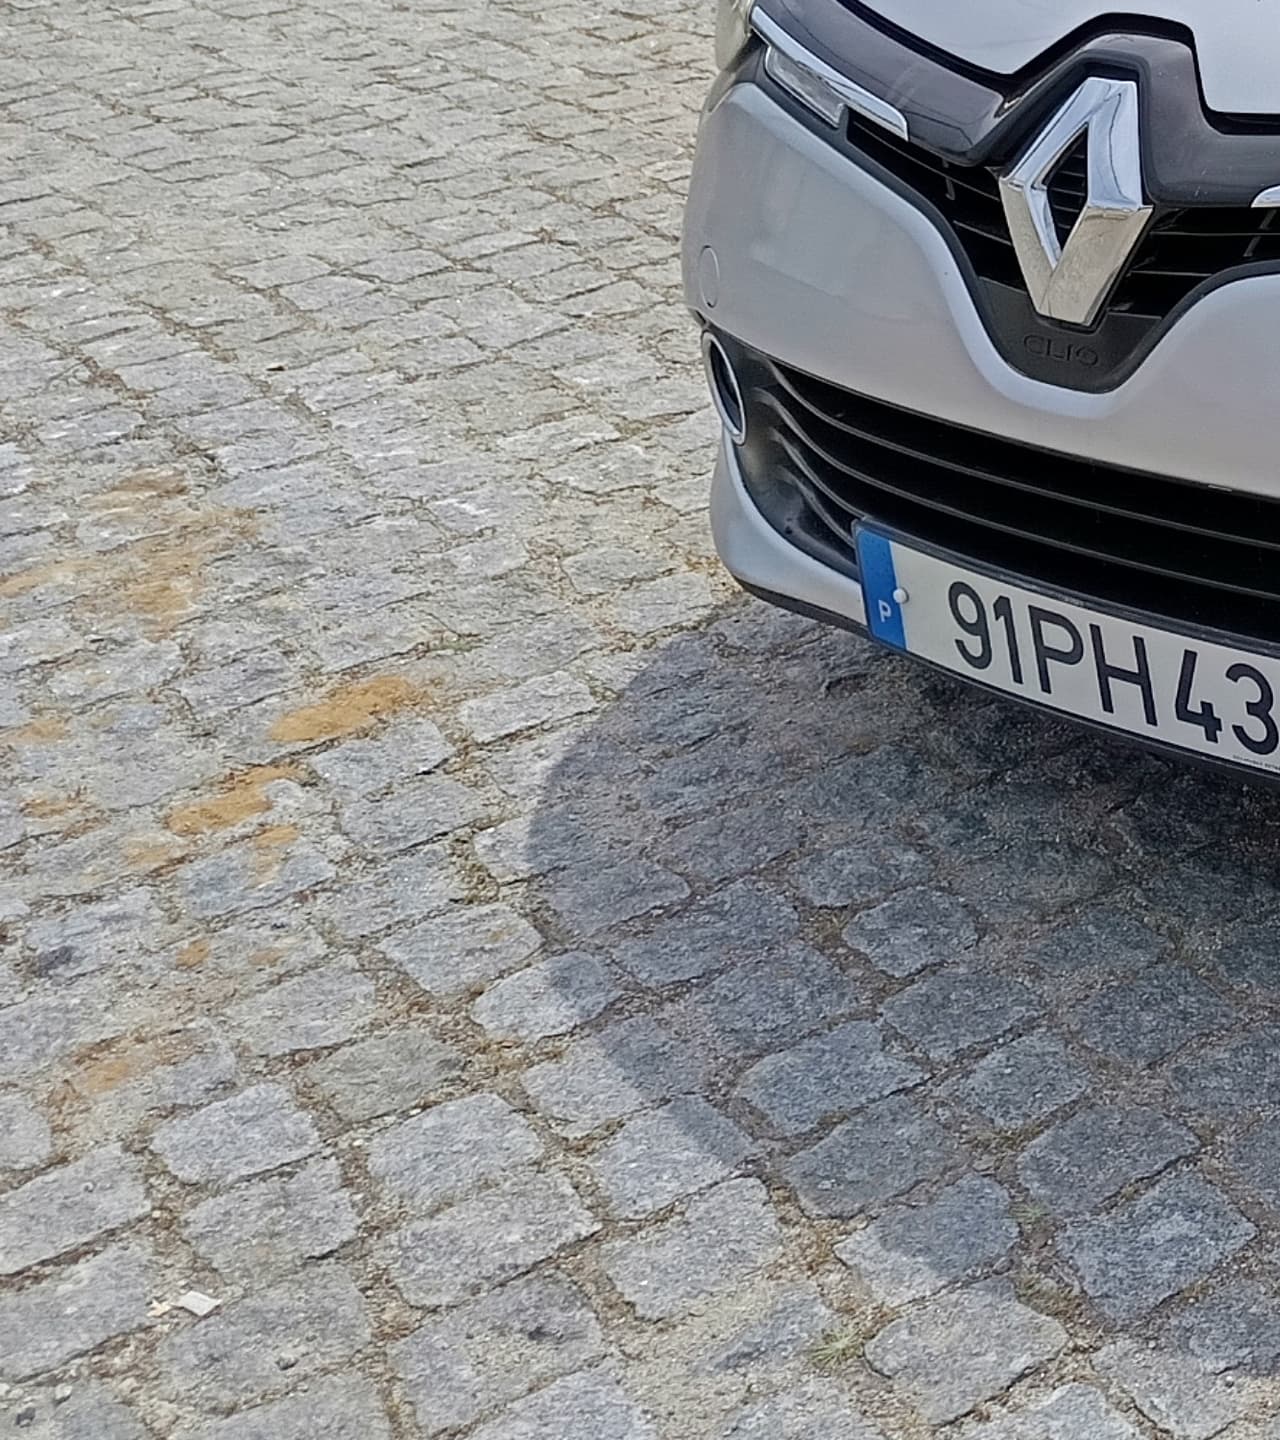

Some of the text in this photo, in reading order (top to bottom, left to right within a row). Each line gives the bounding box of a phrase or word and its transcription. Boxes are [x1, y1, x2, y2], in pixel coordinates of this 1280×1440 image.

[1024, 334, 1098, 366] CLIO
[878, 600, 892, 622] P
[948, 581, 1280, 755] 91PH43
